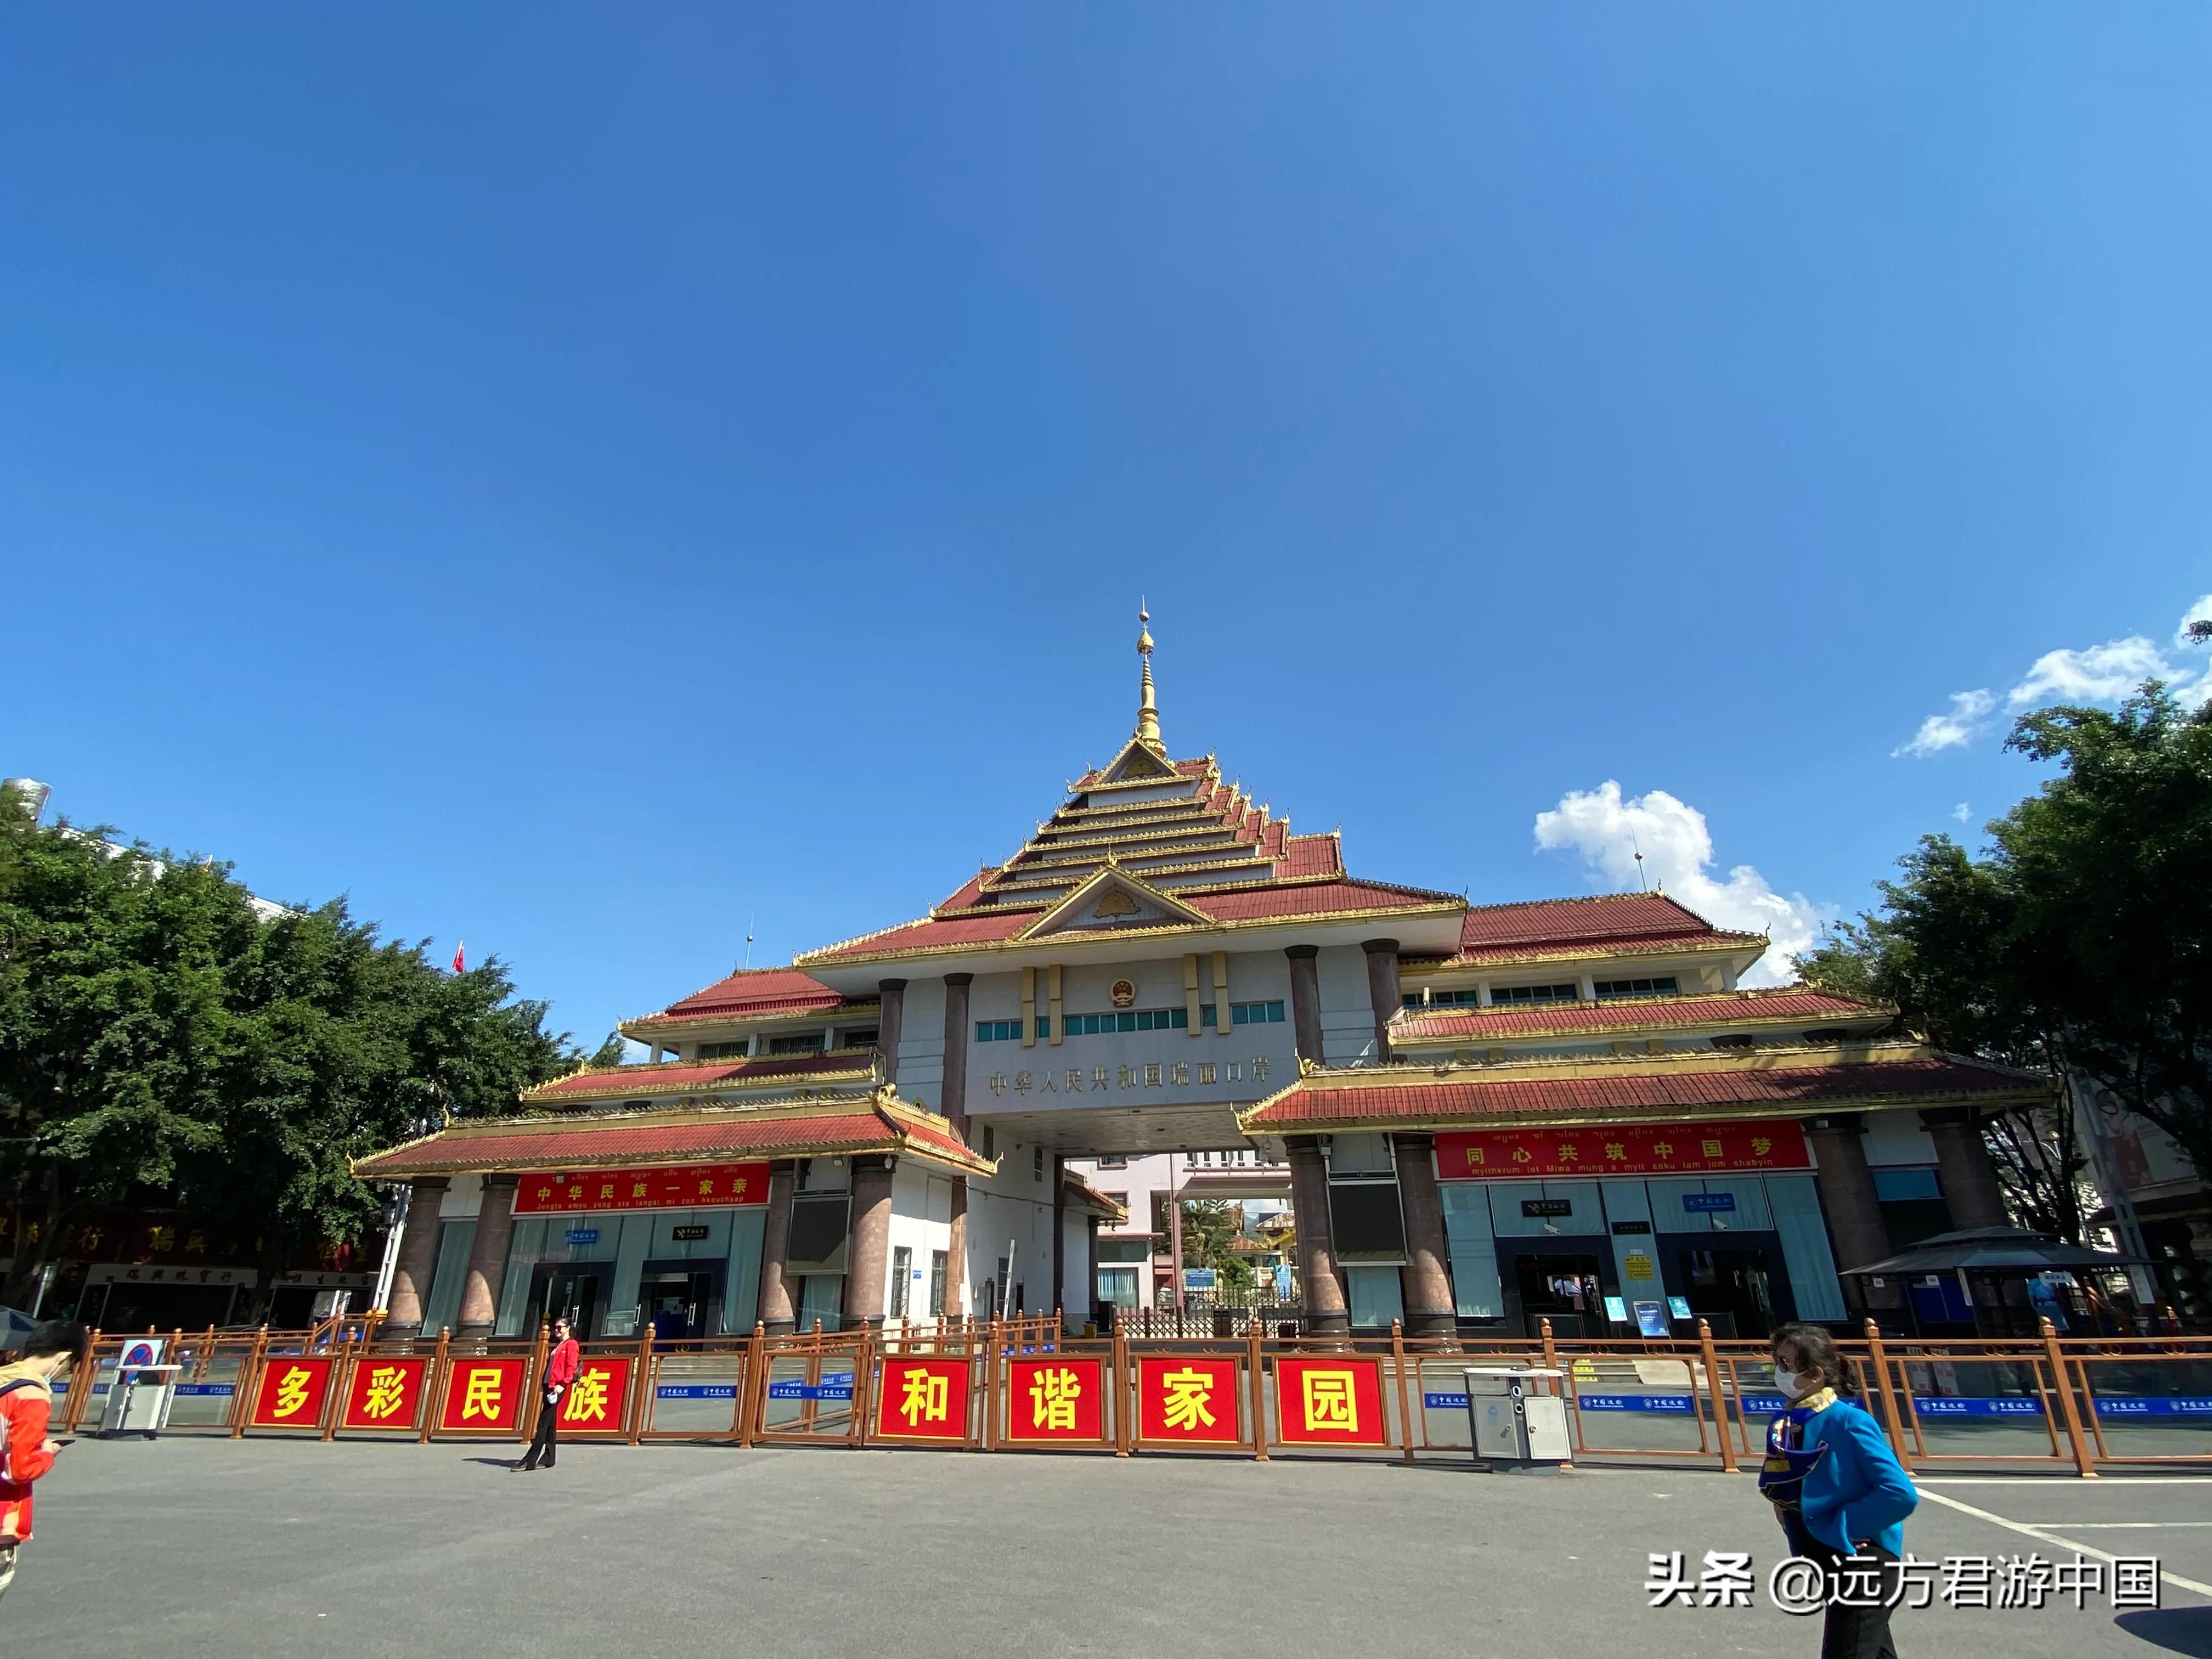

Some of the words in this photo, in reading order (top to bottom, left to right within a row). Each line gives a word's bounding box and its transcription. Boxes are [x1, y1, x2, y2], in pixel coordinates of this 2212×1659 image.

[990, 1056, 1271, 1097] 中华人民共和国瑞丽口岸
[1466, 1137, 1772, 1165] 同心共筑中国梦
[537, 1178, 747, 1201] 中华民族一家亲
